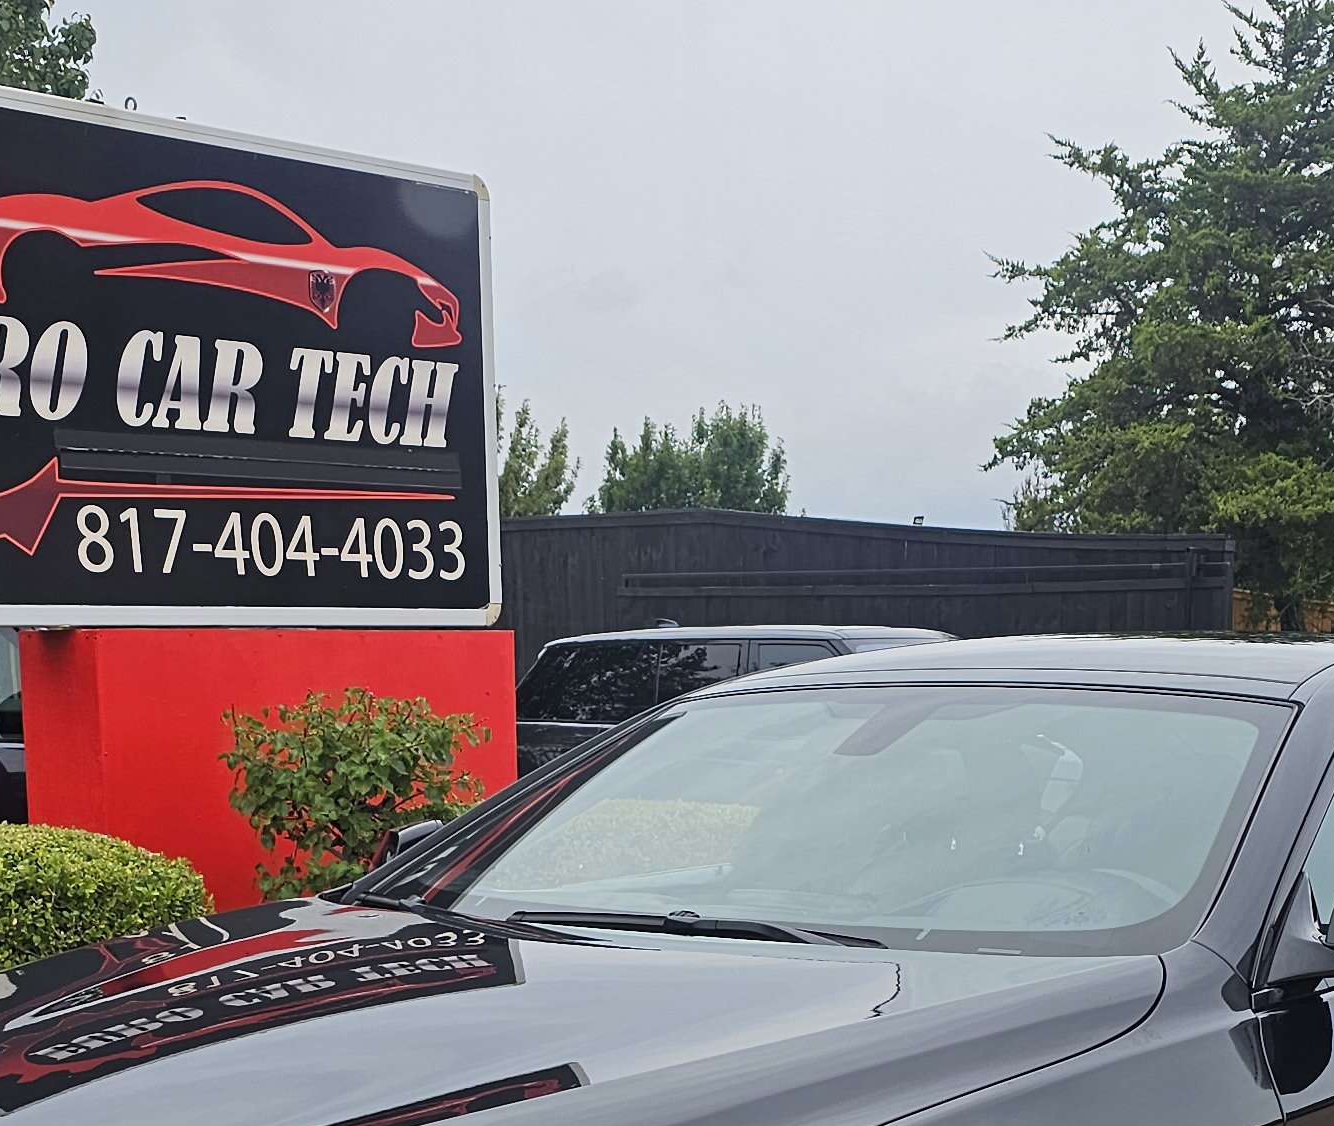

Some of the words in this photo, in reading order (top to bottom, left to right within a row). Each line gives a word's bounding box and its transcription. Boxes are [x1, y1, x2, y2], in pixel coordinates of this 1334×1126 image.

[116, 328, 265, 434] CAR
[288, 346, 459, 448] TECH
[74, 503, 467, 581] 817-404-4033
